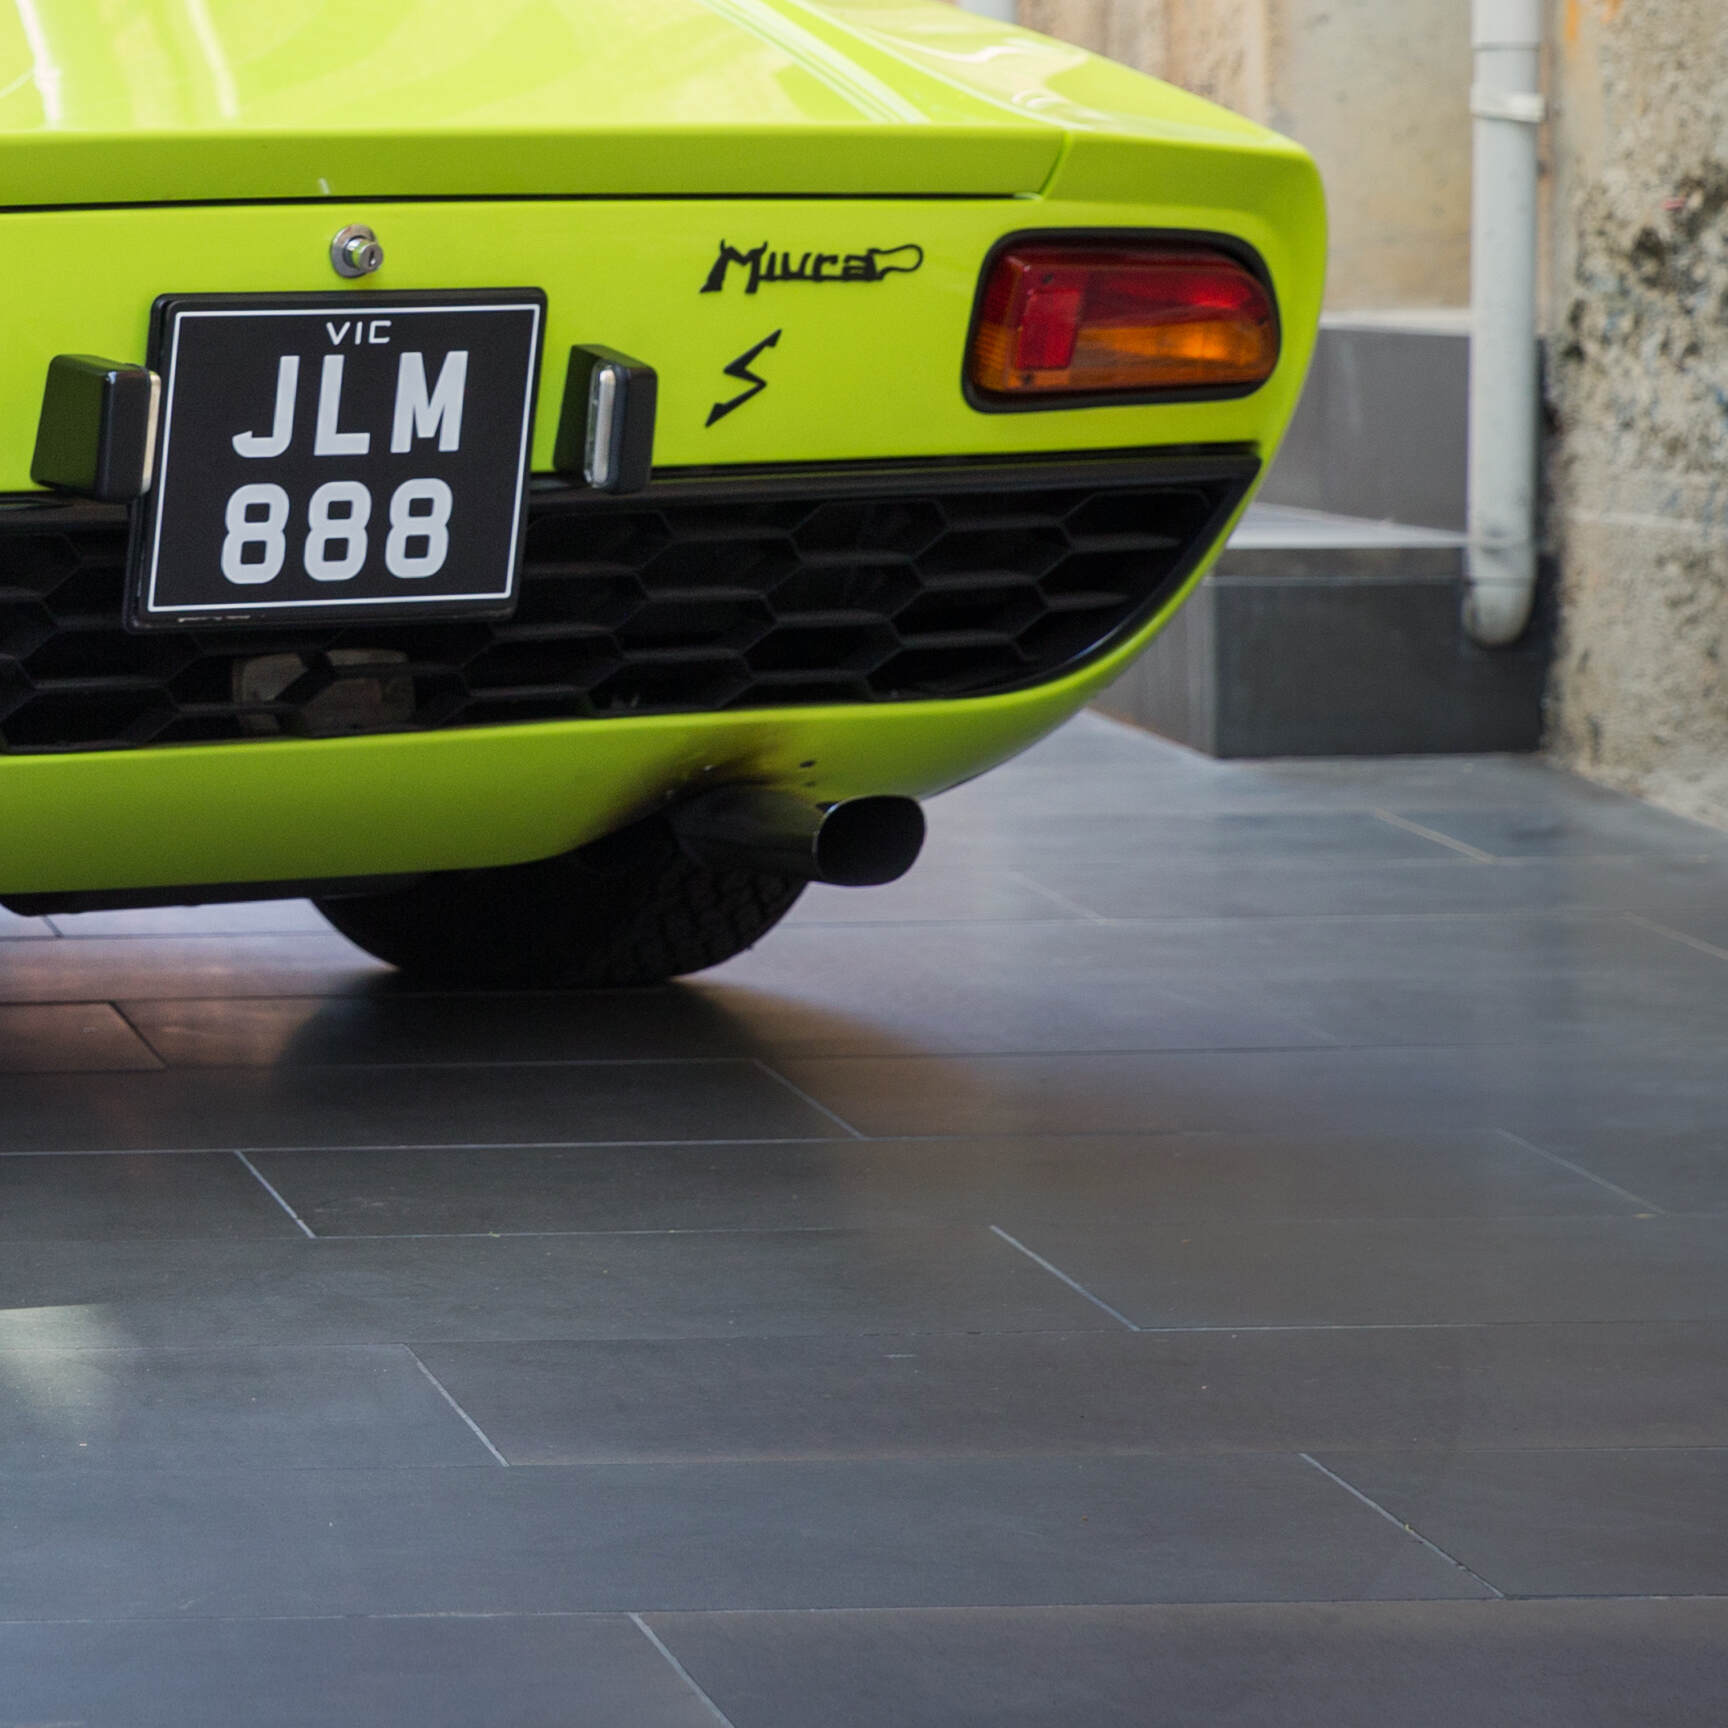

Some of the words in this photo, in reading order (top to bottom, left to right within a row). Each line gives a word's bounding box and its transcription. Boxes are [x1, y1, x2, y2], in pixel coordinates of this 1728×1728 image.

[699, 239, 924, 294] Miura
[325, 320, 393, 346] VIC
[231, 350, 470, 459] JLM
[220, 477, 454, 585] 888
